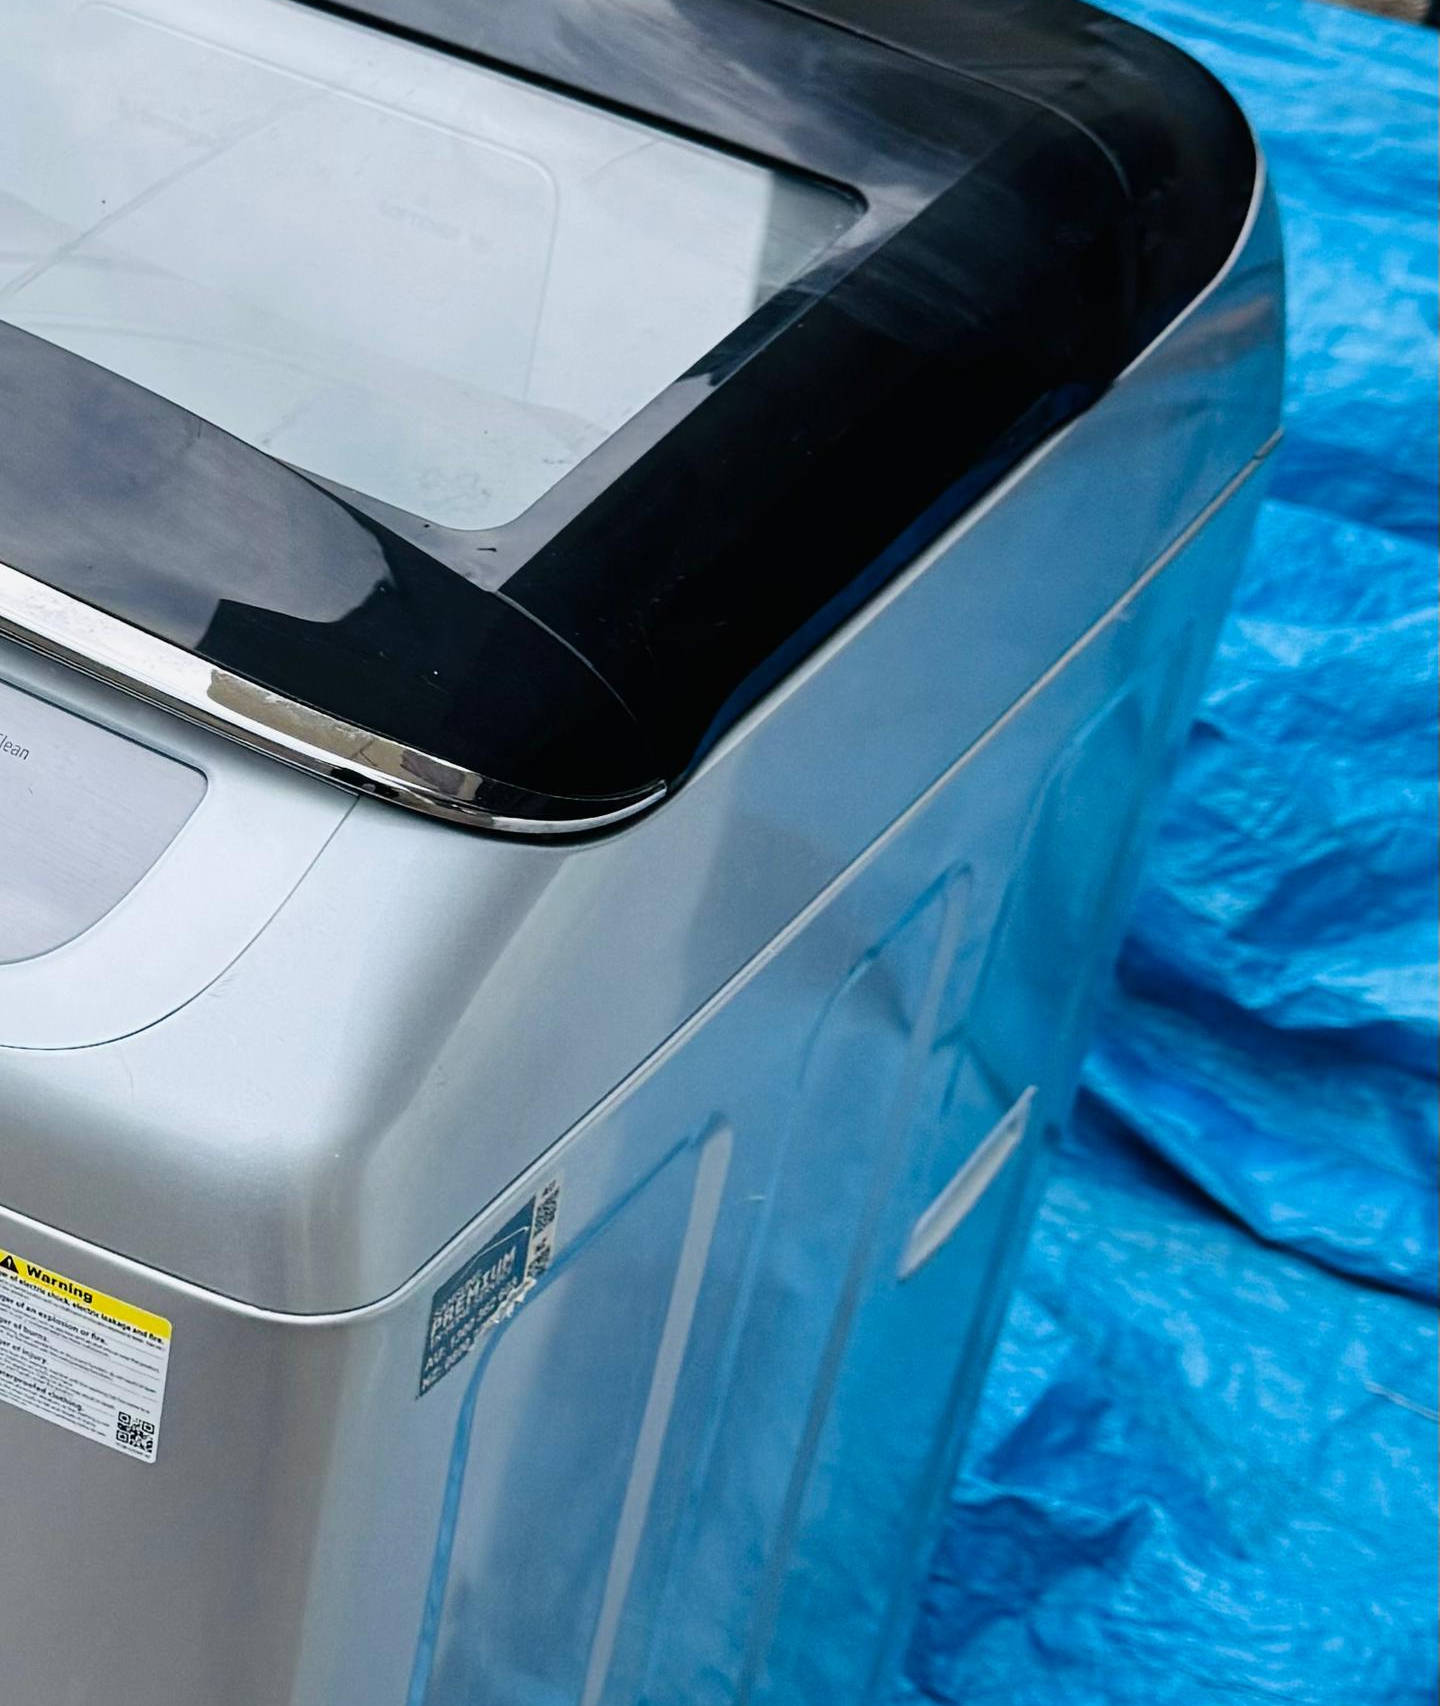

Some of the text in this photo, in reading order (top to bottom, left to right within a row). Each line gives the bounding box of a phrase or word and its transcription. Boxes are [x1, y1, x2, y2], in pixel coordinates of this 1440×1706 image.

[10, 1273, 17, 1282] of
[26, 1264, 93, 1304] Warning
[15, 1299, 24, 1309] of
[26, 1305, 36, 1314] an
[38, 1309, 78, 1333] explosion
[80, 1328, 89, 1337] or
[13, 1321, 21, 1329] of
[12, 1343, 20, 1352] of
